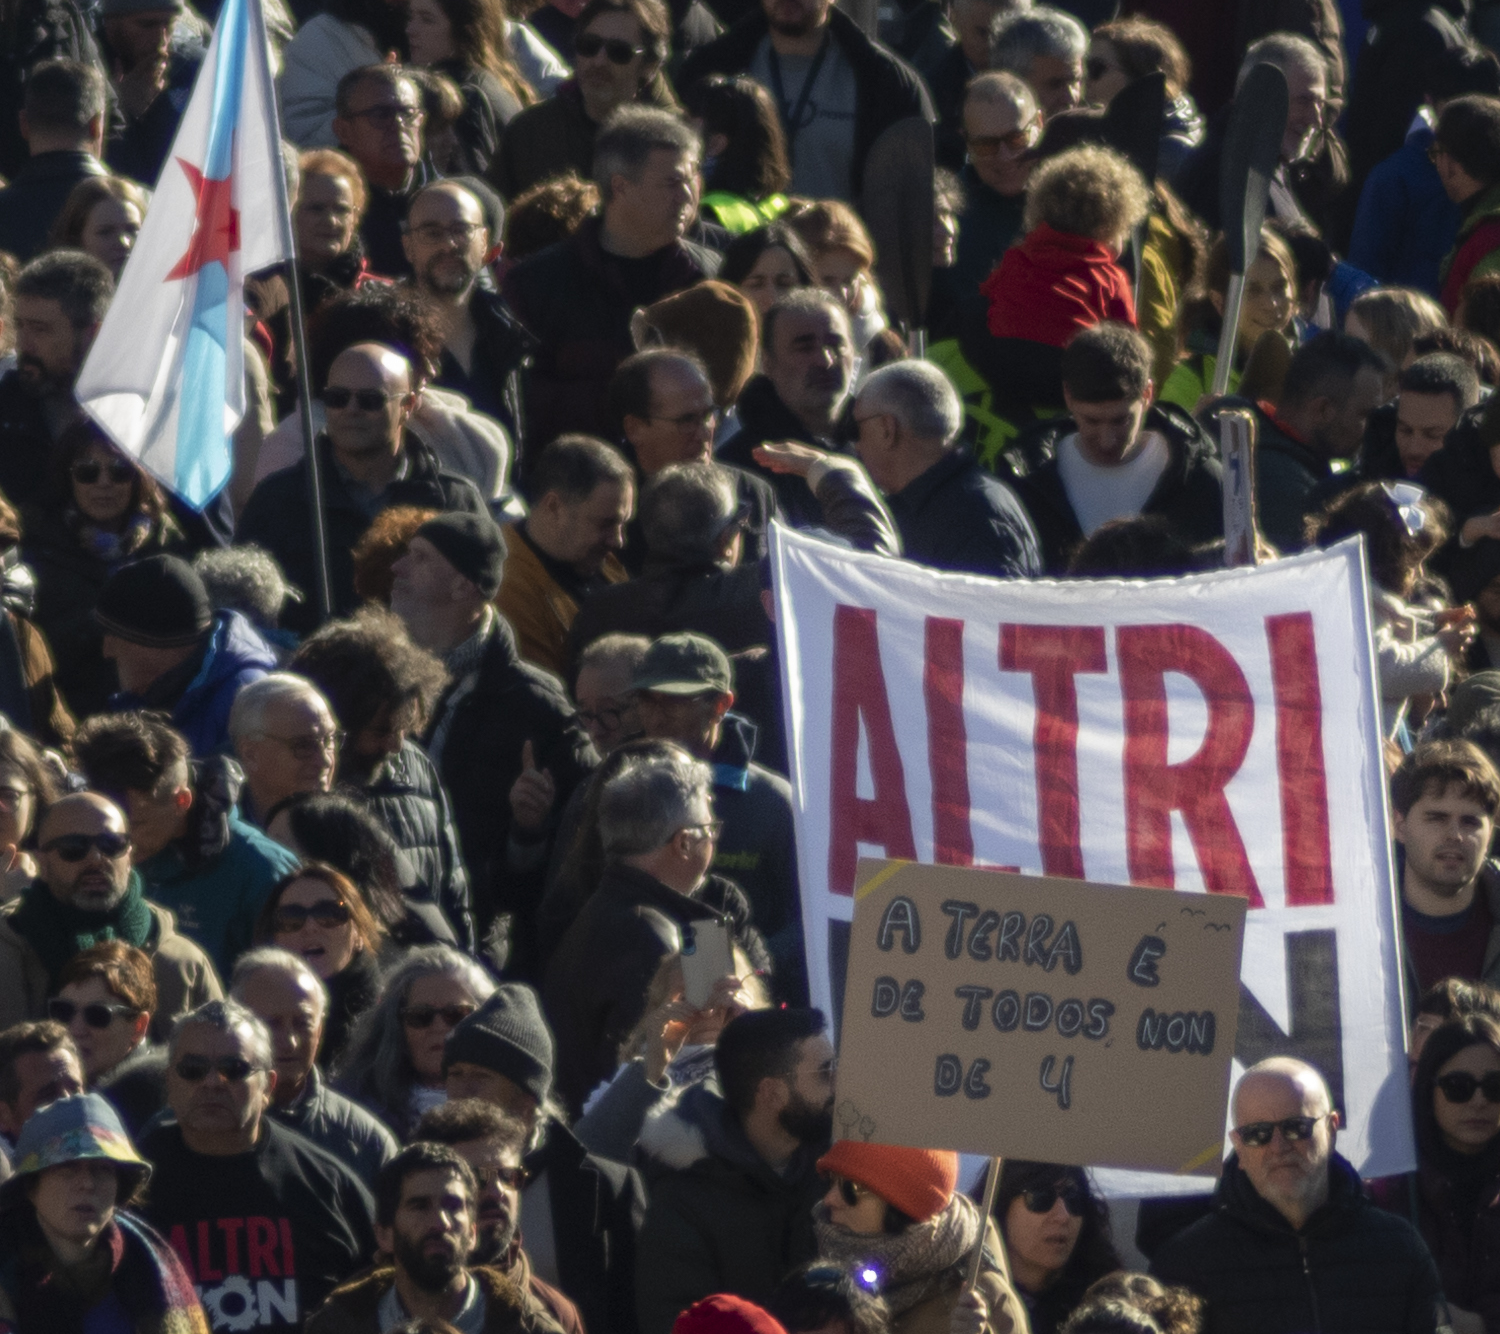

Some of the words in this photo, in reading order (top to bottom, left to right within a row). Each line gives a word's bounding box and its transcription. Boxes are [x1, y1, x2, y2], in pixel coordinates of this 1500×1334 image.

[827, 603, 1334, 909] ALTRI
[876, 898, 921, 954] A
[940, 900, 1081, 973] TERRA
[871, 976, 925, 1023] DE
[1136, 1008, 1216, 1056] NON
[934, 1054, 991, 1100] DE
